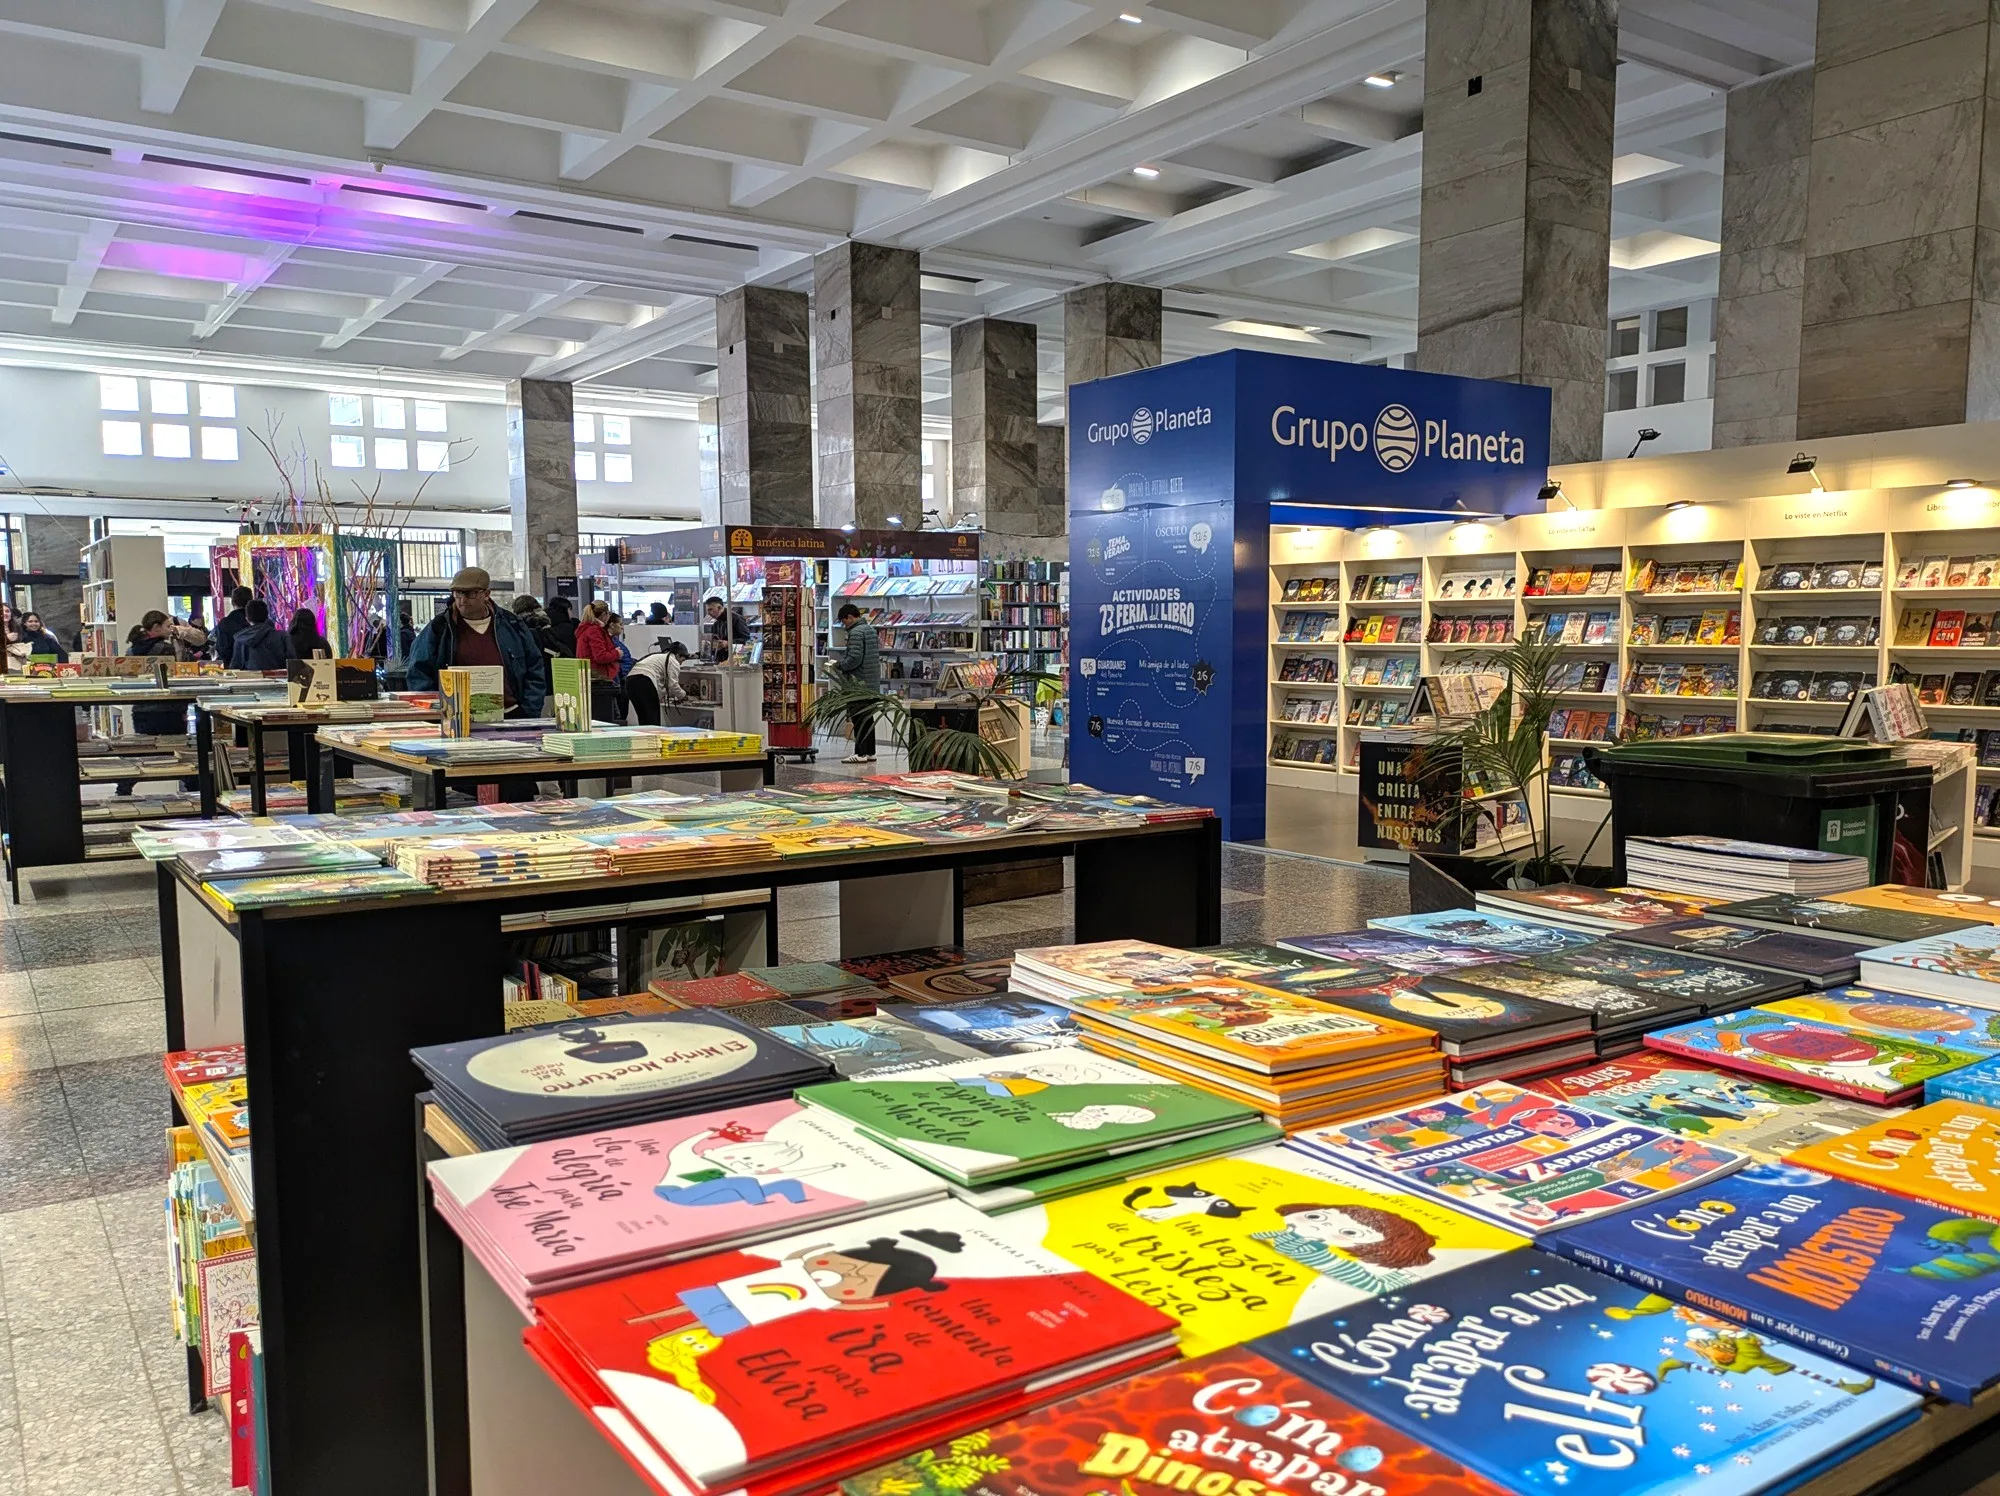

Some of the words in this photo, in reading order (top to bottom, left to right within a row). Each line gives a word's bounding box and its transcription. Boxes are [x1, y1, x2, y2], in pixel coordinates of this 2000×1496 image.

[1088, 422, 1129, 446] Grupo
[1155, 405, 1212, 432] Planeta
[1271, 405, 1368, 462] Grupo
[1424, 419, 1525, 464] Planeta
[1822, 510, 1848, 518] Netflix
[756, 537, 796, 548] américa
[797, 538, 825, 549] latina
[1156, 525, 1187, 537] ÓSCULO
[1112, 588, 1181, 602] ACTIVIDADES
[1116, 603, 1148, 628] FERIA
[1161, 602, 1195, 627] LIBRO
[1164, 623, 1193, 635] MONTEVIDEO
[1097, 660, 1126, 670] GUARDIANES
[1147, 661, 1163, 673] amiga
[1107, 717, 1124, 726] Nuevas
[1125, 718, 1142, 727] formas
[1152, 720, 1179, 729] escritura
[1378, 761, 1402, 776] UNA
[1378, 782, 1421, 799] GRIETA
[1377, 805, 1414, 820] ENTRE
[1376, 824, 1442, 844] NOSOTROS
[1228, 1021, 1316, 1046] SAWYER
[1317, 1016, 1370, 1037] TOM
[660, 1044, 721, 1068] Ninja
[723, 1040, 749, 1051] El
[542, 1060, 663, 1093] Nocturno
[1562, 1065, 1633, 1089] BLUES
[1589, 1073, 1680, 1100] PERROS
[917, 1091, 935, 1099] de
[936, 1085, 1033, 1125] espinita
[852, 1087, 890, 1105] para
[886, 1101, 968, 1143] Marcelo
[918, 1096, 983, 1127] celos
[1940, 1114, 1988, 1131] un
[633, 1137, 660, 1157] Una
[1938, 1131, 1971, 1140] a
[1378, 1127, 1526, 1172] ASTRONAUTAS
[1509, 1132, 1644, 1182] ZAPATEROS
[546, 1144, 633, 1203] alegría
[605, 1157, 625, 1170] de
[1924, 1138, 1988, 1192] atrapar
[544, 1186, 585, 1211] para
[1785, 1193, 1823, 1215] un
[491, 1180, 543, 1212] José
[526, 1208, 577, 1258] María
[1771, 1208, 1800, 1223] a
[1106, 1220, 1132, 1237] de
[1174, 1218, 1205, 1239] Un
[1689, 1211, 1782, 1270] atrapar
[1072, 1239, 1125, 1266] para
[1198, 1232, 1302, 1288] tazón
[1573, 1248, 1602, 1267] Elkerton
[1746, 1207, 1905, 1312] MONSTRUO
[1118, 1229, 1270, 1313] tristeza
[1628, 1267, 1656, 1286] Wallace
[1109, 1266, 1199, 1319] Leiza
[1512, 1282, 1599, 1314] un
[961, 1297, 1003, 1326] Una
[1490, 1301, 1540, 1326] a
[1685, 1289, 1748, 1322] MONSTRUO
[1749, 1312, 1764, 1322] un
[902, 1294, 1018, 1370] tormenta
[905, 1329, 933, 1350] de
[1310, 1303, 1451, 1376] Cómo
[1774, 1320, 1817, 1347] atrapar
[826, 1323, 907, 1378] ira
[1818, 1337, 1849, 1359] Cómo
[1382, 1315, 1513, 1416] atrapar
[735, 1347, 830, 1422] Elvira
[815, 1359, 870, 1399] para
[1502, 1361, 1660, 1471] elfo
[1168, 1425, 1389, 1496] atrapar
